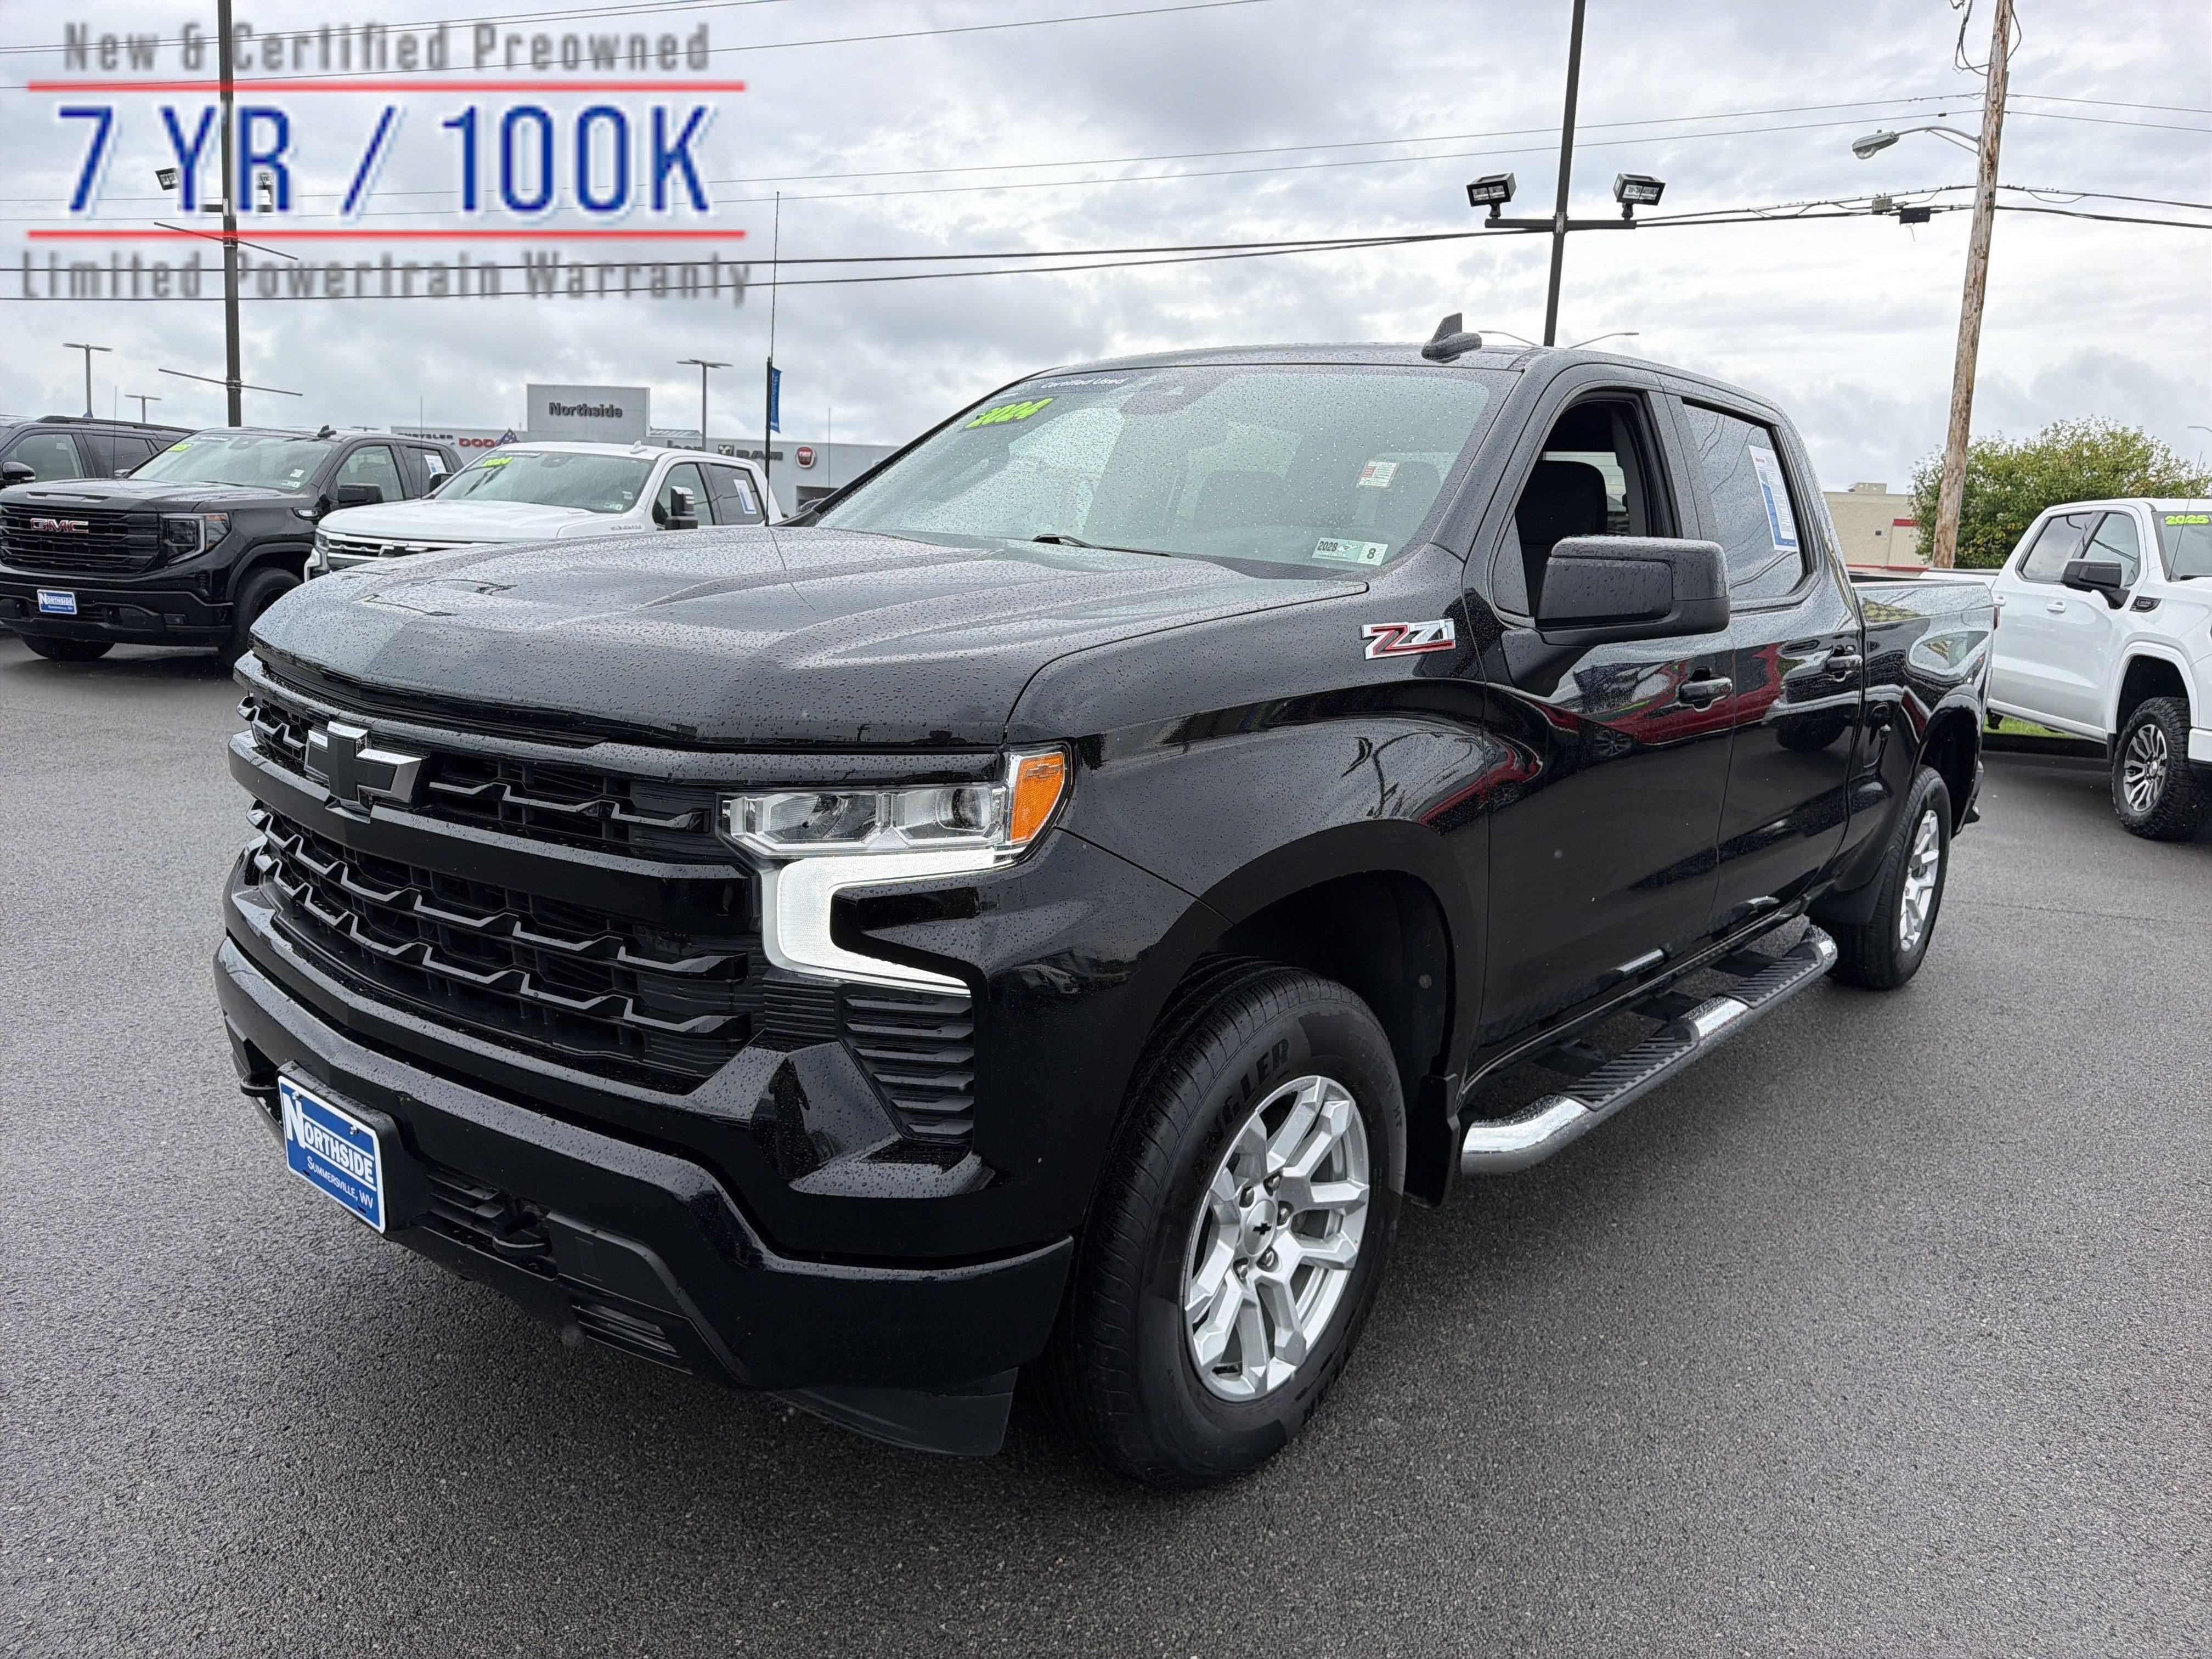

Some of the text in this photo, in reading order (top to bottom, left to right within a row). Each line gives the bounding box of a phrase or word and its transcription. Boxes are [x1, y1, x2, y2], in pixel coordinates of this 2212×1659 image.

[549, 402, 623, 418] Northside
[459, 437, 499, 447] DOD
[736, 449, 783, 461] RAM
[30, 517, 89, 534] GMC
[2165, 514, 2209, 526] 2025
[1317, 540, 1339, 553] 2028
[1366, 548, 1377, 560] 8
[282, 1092, 375, 1185] NORTHSIDE
[358, 1189, 374, 1210] WV
